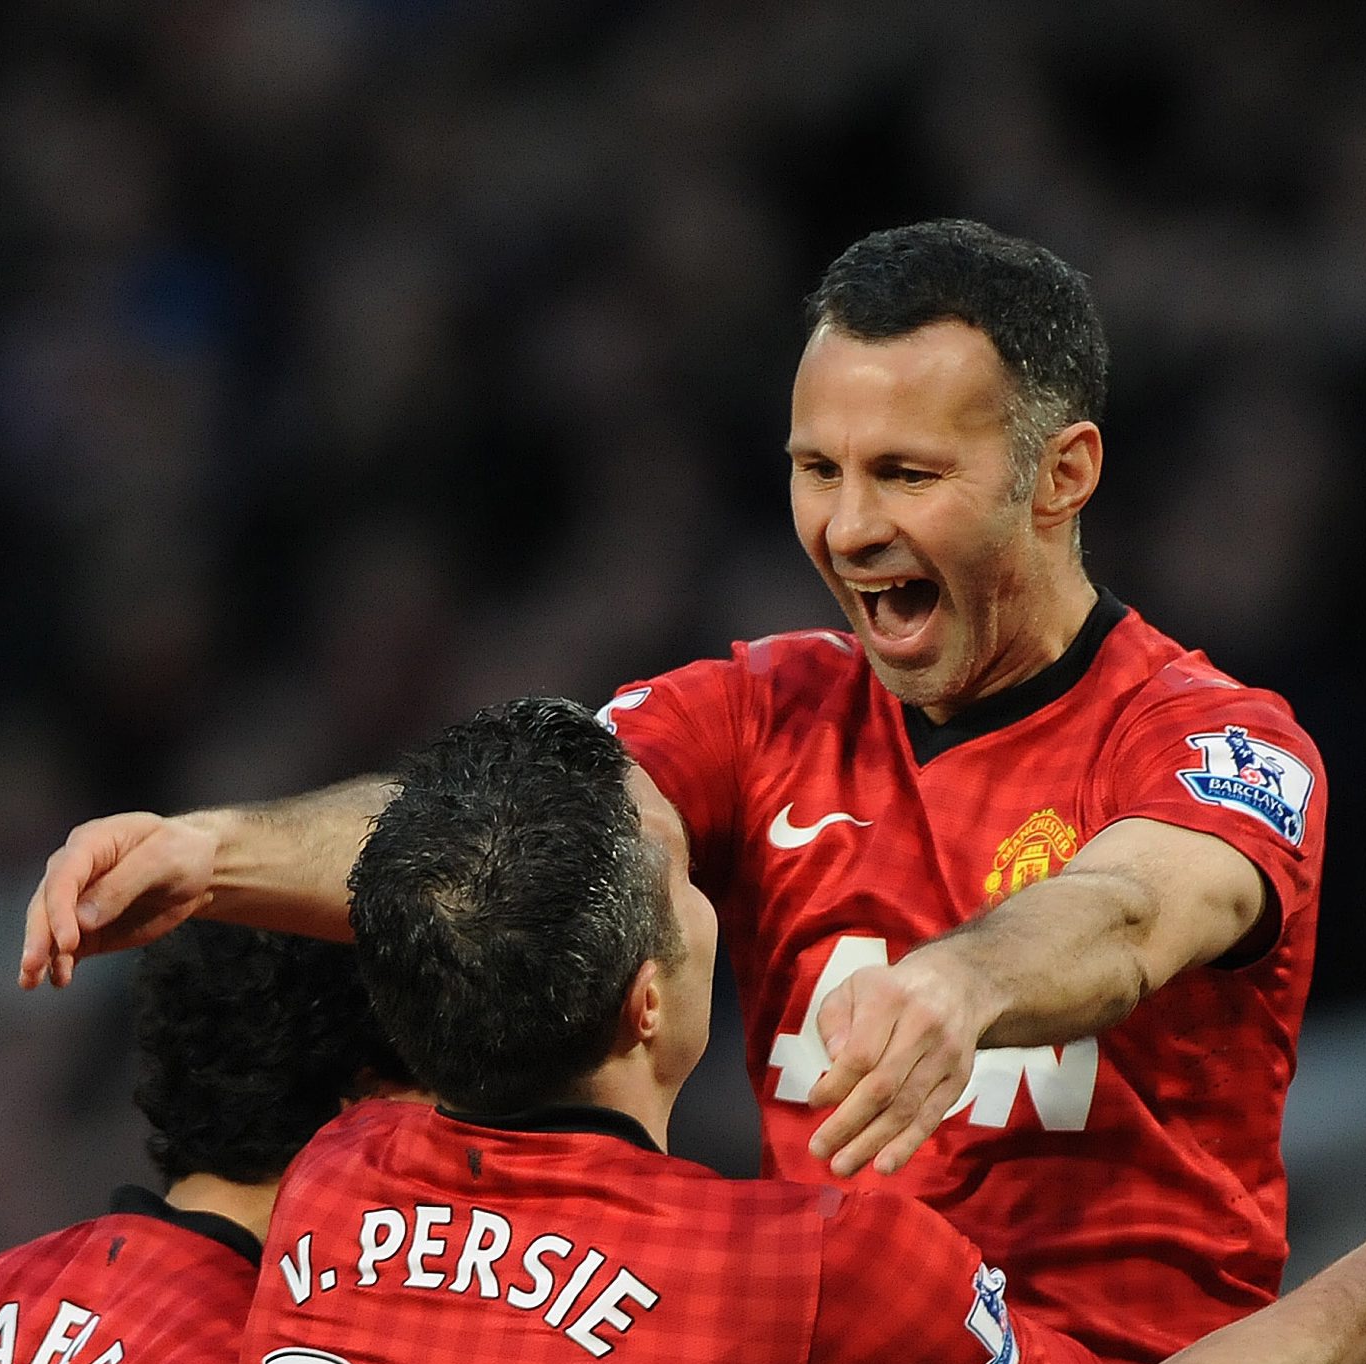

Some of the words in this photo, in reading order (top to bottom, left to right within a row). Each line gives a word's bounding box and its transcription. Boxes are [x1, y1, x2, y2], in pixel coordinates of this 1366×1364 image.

[1002, 818, 1071, 861] MANCHESTER
[1208, 778, 1284, 817] BARCLAYS
[769, 935, 1099, 1132] AN
[356, 1205, 658, 1359] PERSIE
